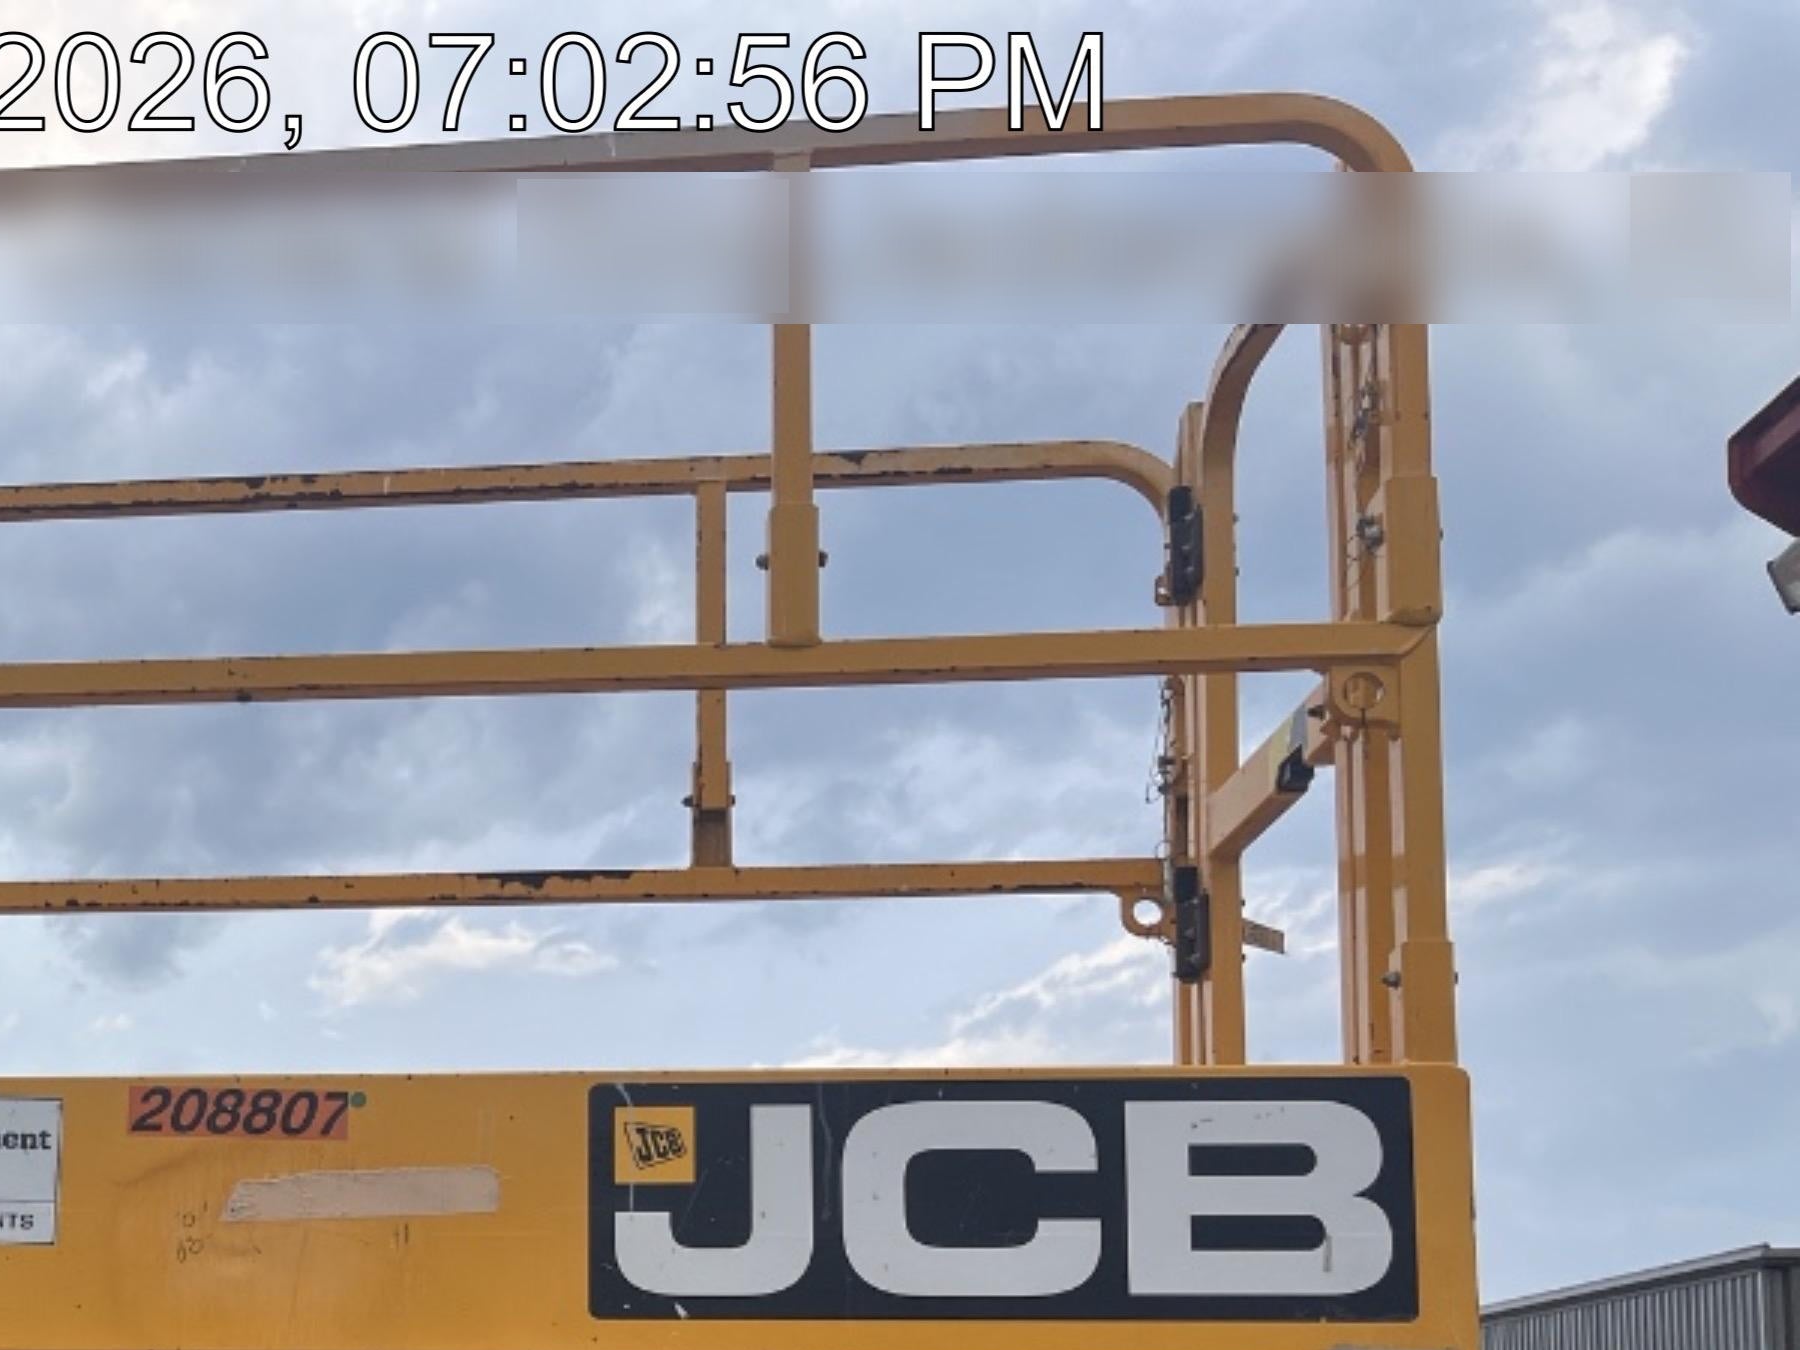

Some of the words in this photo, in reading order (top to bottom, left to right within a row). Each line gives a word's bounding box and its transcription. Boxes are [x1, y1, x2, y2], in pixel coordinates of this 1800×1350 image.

[130, 1085, 349, 1136] 208807
[635, 1127, 682, 1162] JCB
[615, 1099, 1394, 1298] JCB
